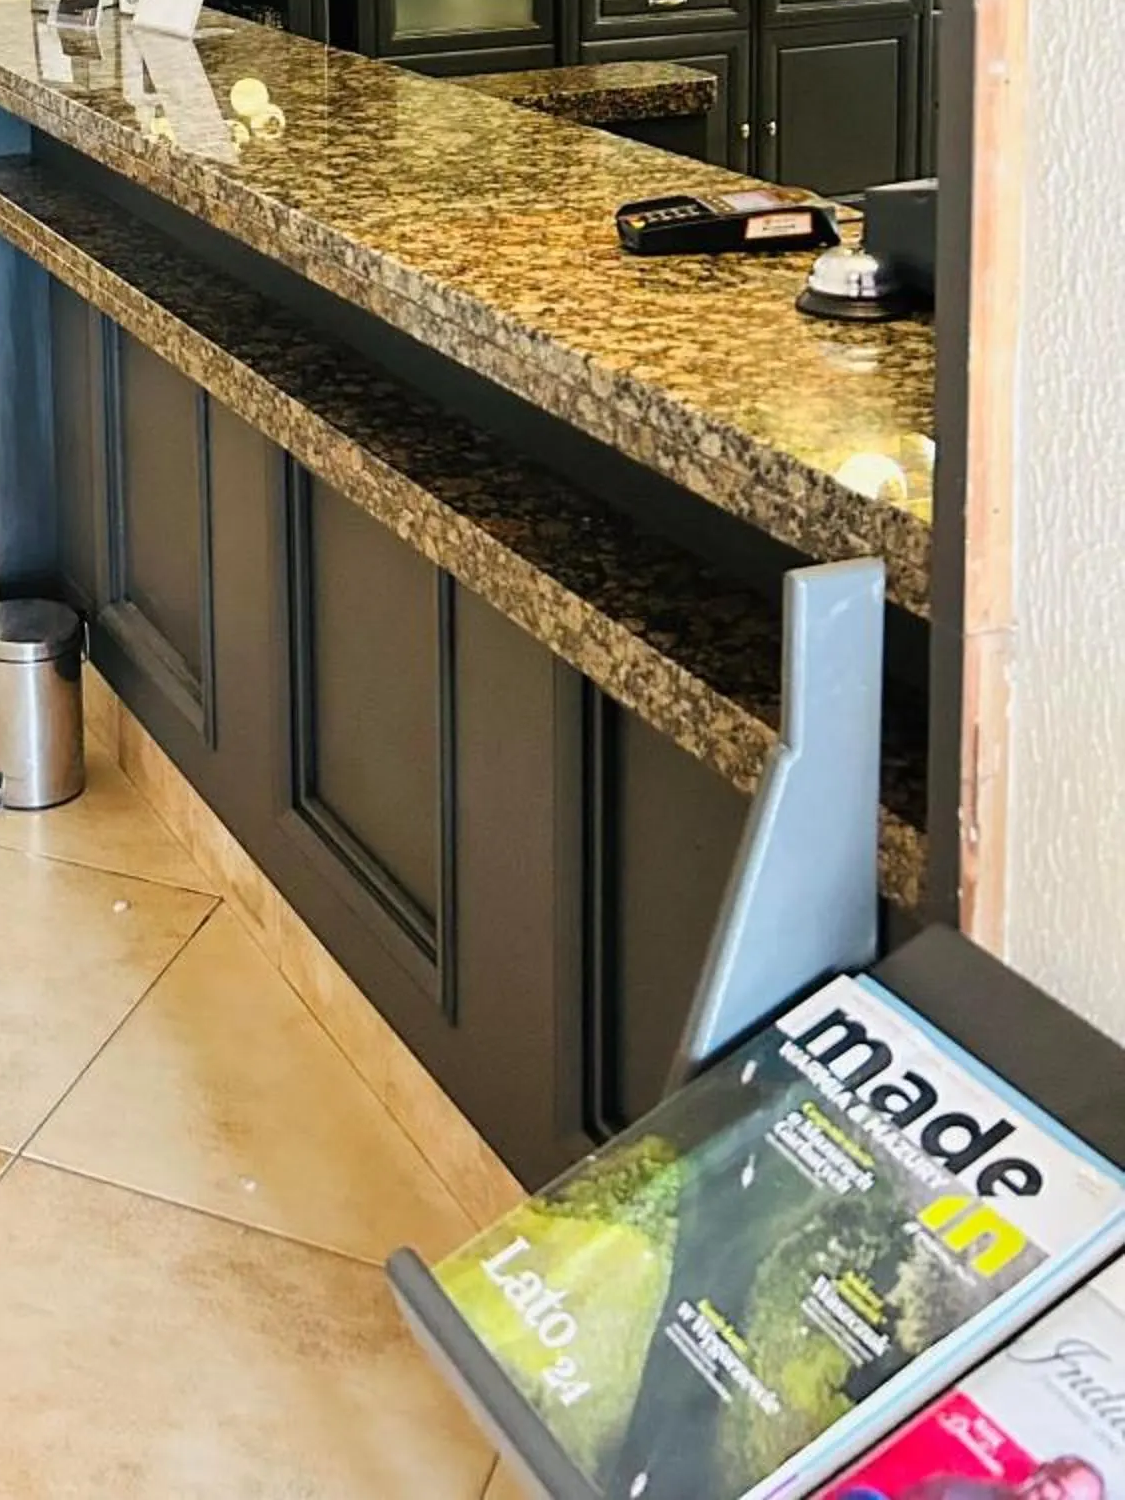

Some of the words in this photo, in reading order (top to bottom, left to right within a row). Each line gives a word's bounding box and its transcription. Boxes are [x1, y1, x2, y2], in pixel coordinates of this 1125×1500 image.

[790, 1007, 1043, 1197] made
[862, 1111, 951, 1189] MAZURY
[916, 1194, 1027, 1277] in
[479, 1235, 578, 1348] Lato
[542, 1355, 591, 1408] 24
